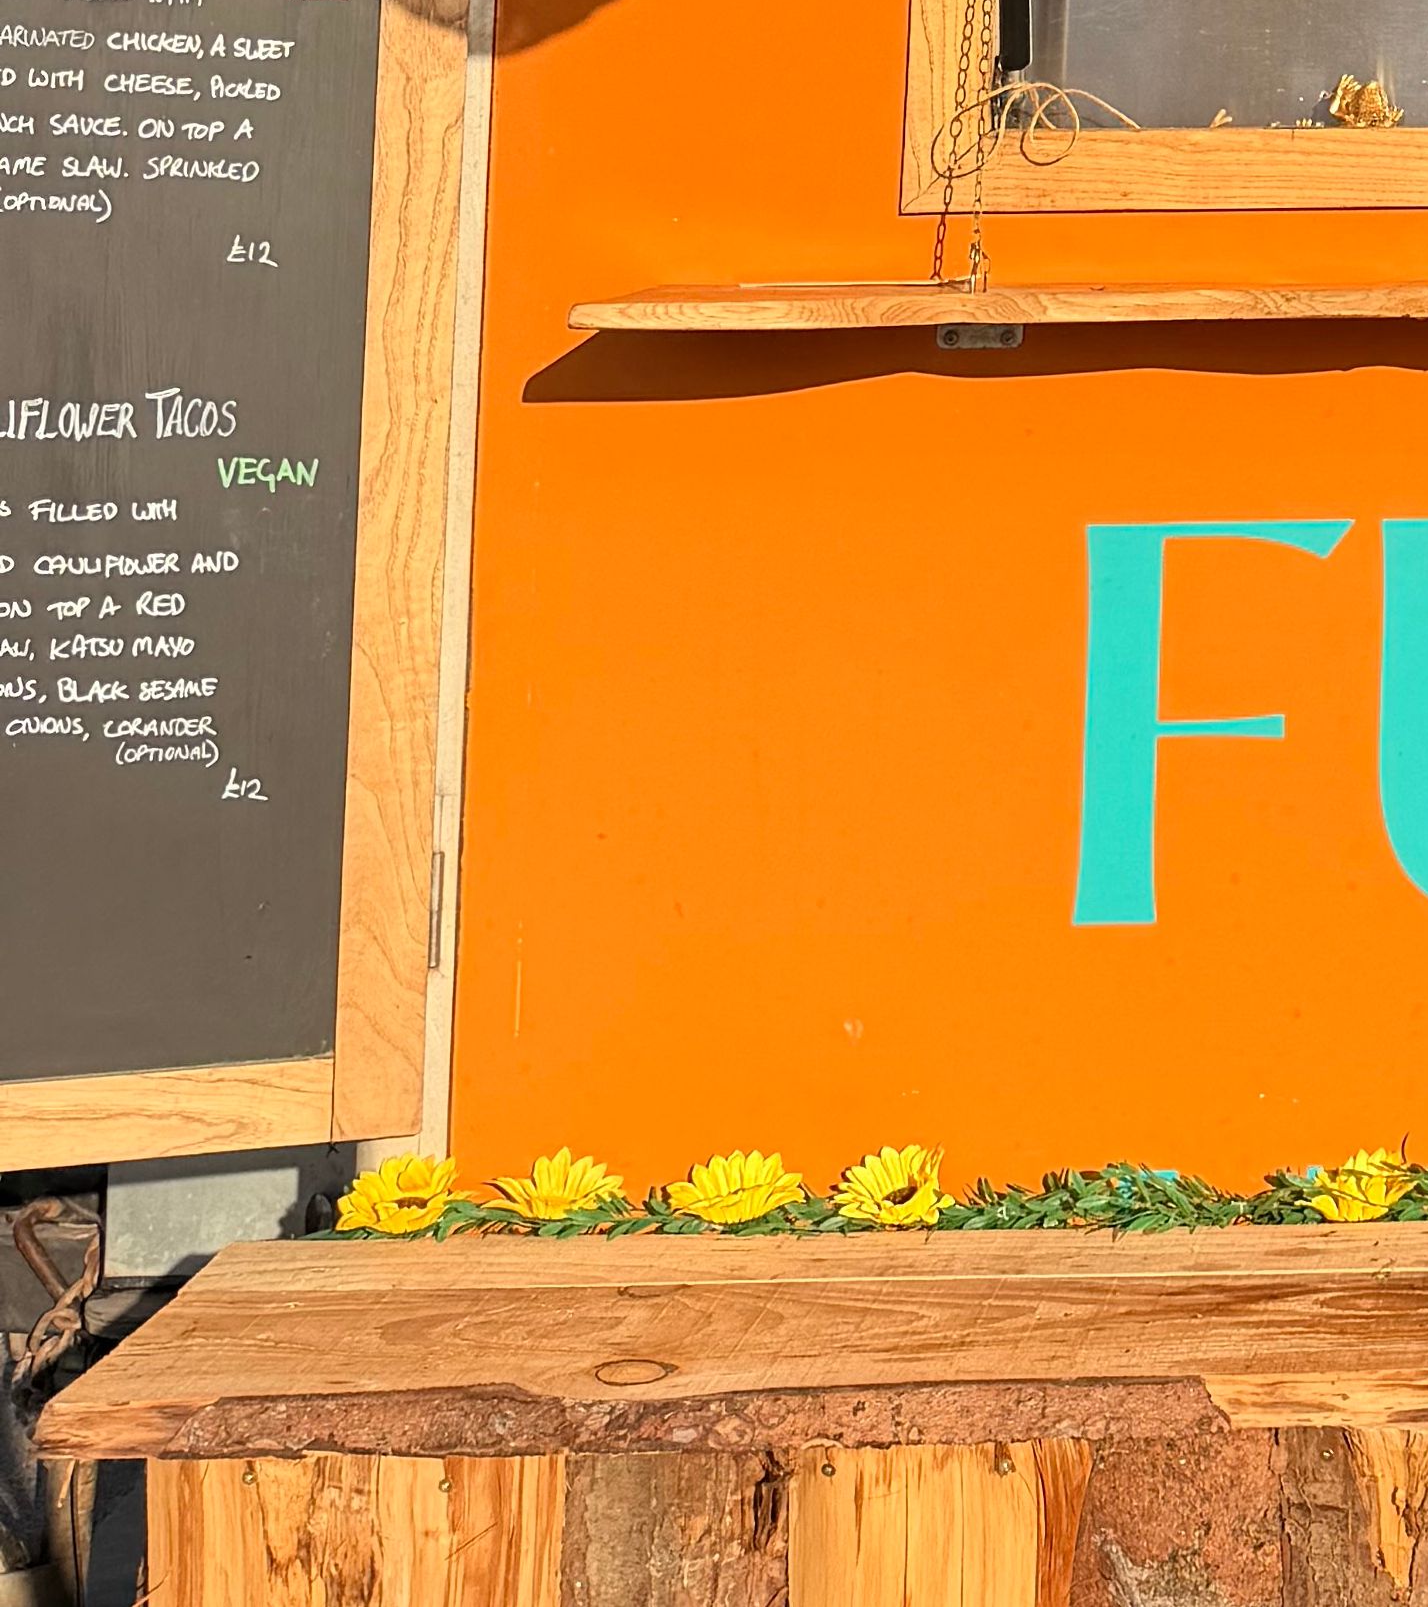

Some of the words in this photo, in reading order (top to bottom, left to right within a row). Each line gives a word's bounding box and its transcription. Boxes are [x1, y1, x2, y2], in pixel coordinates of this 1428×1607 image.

[107, 32, 203, 60] CHICKEN,
[210, 34, 226, 56] A
[28, 68, 84, 91] WITH
[104, 74, 201, 101] CHEESE,
[211, 76, 281, 101] PICKLED
[50, 114, 128, 136] SAUCE.
[138, 118, 175, 139] ON
[182, 121, 225, 141] TOP
[234, 123, 254, 141] A
[62, 156, 129, 179] SLAW.
[143, 154, 260, 183] SPRINKLED
[227, 235, 278, 267] £12
[0, 397, 138, 442] IFLOWER
[145, 387, 237, 439] TACOS
[217, 457, 319, 493] VEGAN
[28, 499, 118, 522] FILLED
[132, 500, 177, 522] WITH
[191, 551, 239, 573] AND
[47, 597, 90, 620] TOP
[99, 596, 121, 619] A
[136, 591, 186, 616] RED
[50, 634, 124, 660] KATSU
[132, 636, 195, 658] MAYO
[57, 677, 129, 703] BLACK
[139, 677, 219, 701] SESAME
[6, 716, 90, 742] ONIONS,
[115, 739, 219, 768] (OPTIONAL)
[221, 768, 269, 801] £12
